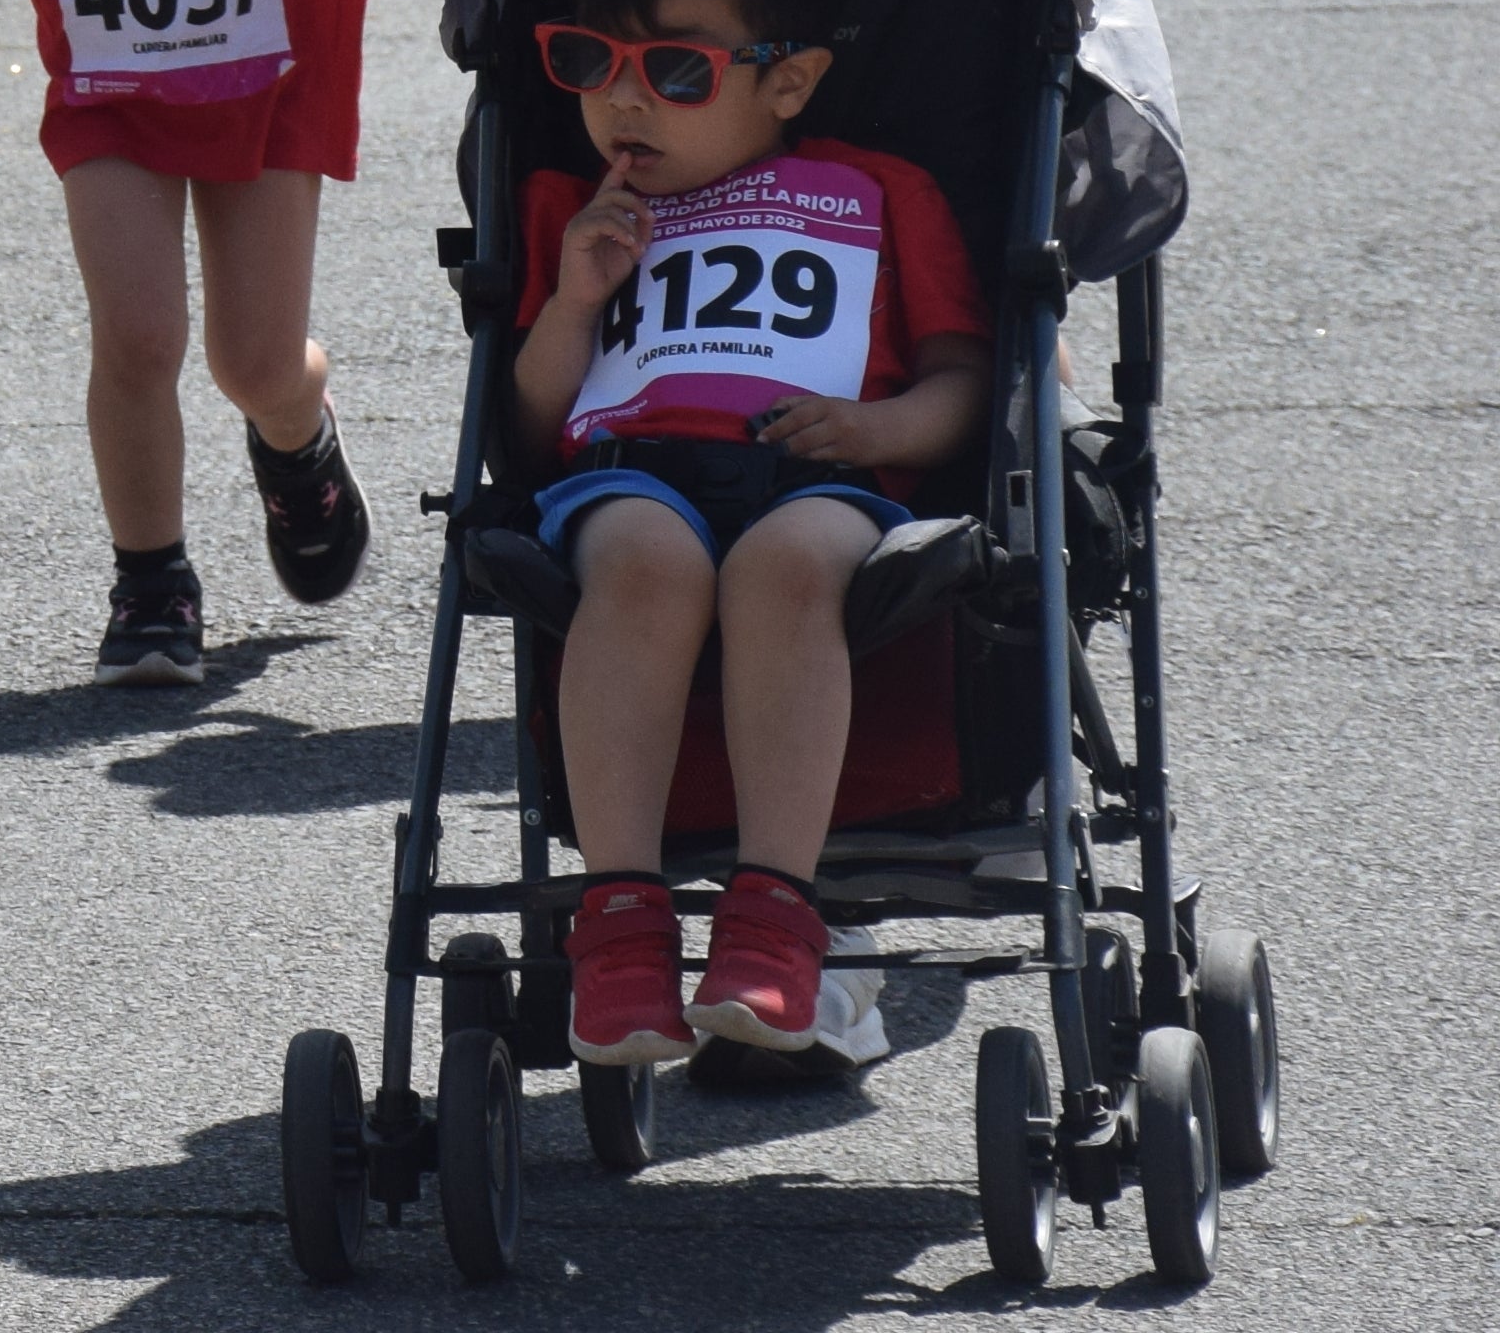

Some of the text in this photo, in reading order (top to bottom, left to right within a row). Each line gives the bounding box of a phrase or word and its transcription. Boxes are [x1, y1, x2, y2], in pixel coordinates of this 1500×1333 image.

[685, 172, 776, 203] CAMPUS
[727, 188, 861, 217] DE LA RIOJA
[665, 223, 686, 237] DE
[689, 216, 735, 231] MAYO
[739, 215, 761, 225] DE
[766, 215, 805, 230] 2022
[602, 244, 838, 357] 4129
[637, 342, 773, 370] CARRERA FAMILIAR
